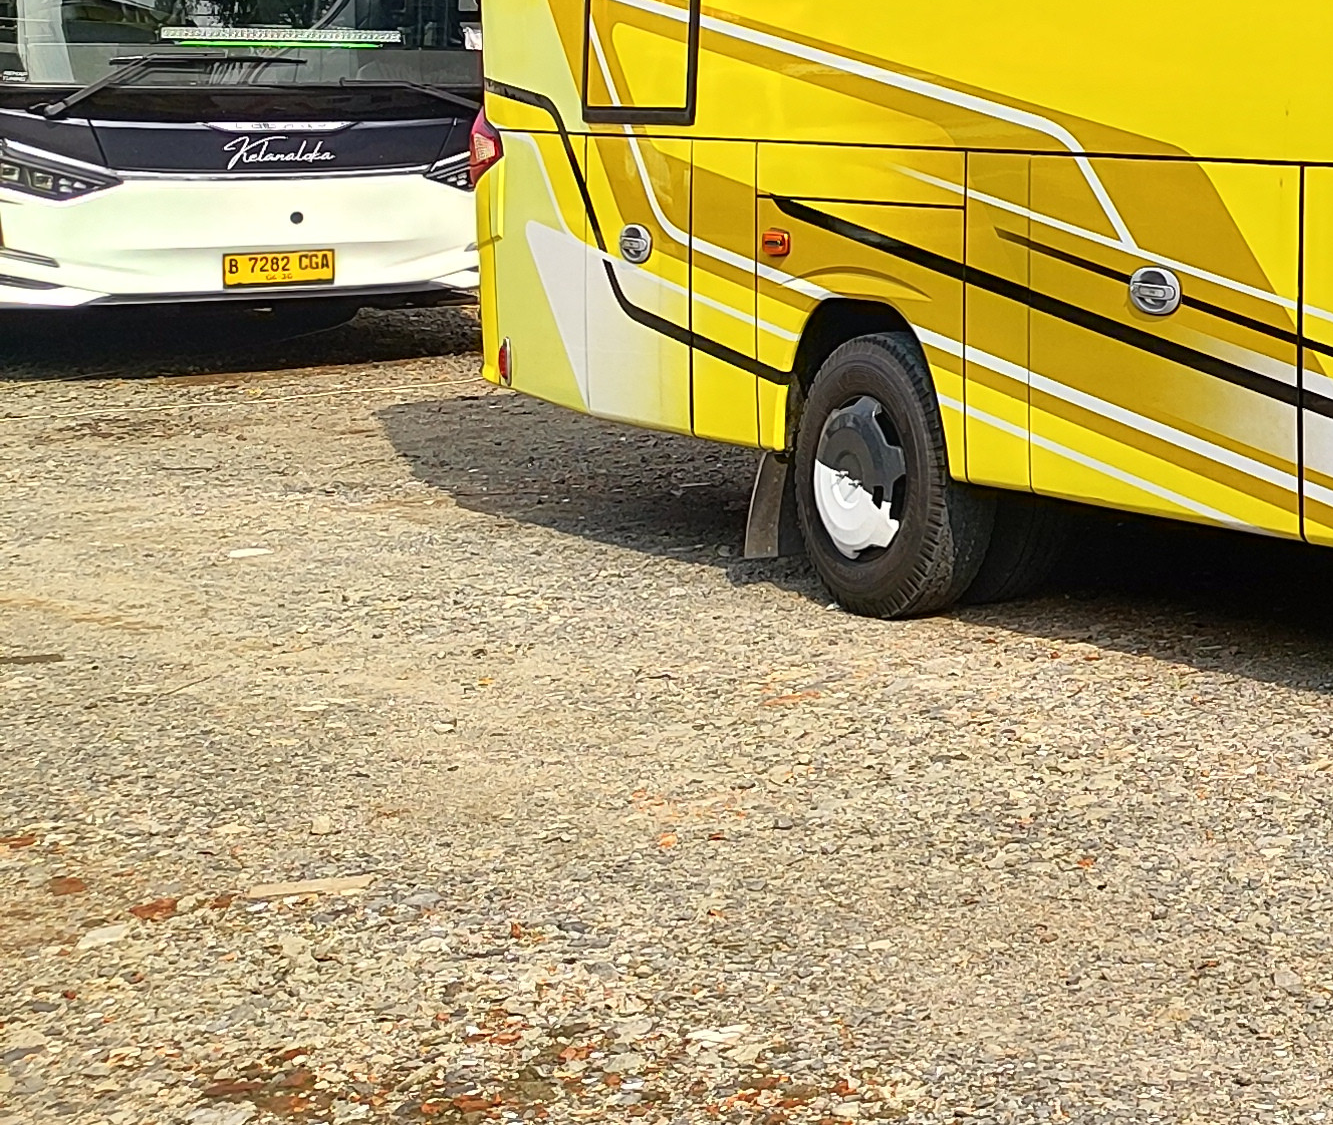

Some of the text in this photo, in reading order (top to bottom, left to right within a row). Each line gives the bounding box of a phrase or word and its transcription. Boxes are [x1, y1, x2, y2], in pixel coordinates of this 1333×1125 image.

[222, 135, 336, 171] Kelanaloka
[228, 254, 330, 274] B 7282 CGA
